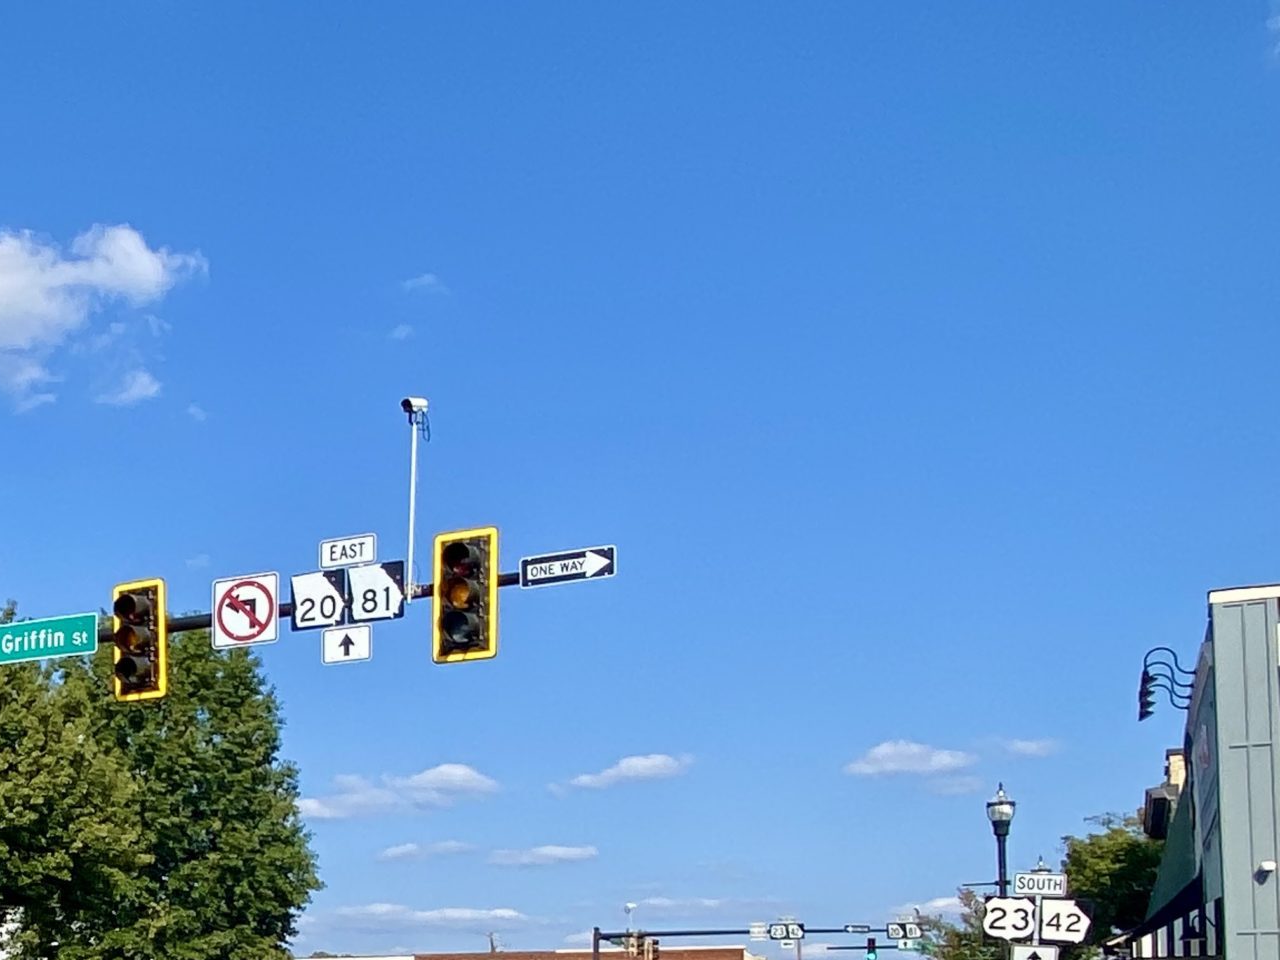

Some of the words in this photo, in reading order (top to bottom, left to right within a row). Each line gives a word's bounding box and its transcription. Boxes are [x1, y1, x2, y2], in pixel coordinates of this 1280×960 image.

[329, 542, 366, 562] EAST
[530, 563, 556, 578] ONE
[560, 560, 585, 573] WAY
[300, 595, 336, 622] 20
[361, 586, 390, 613] 81
[1, 628, 65, 654] Griffin
[1016, 876, 1063, 891] SOUTH
[988, 907, 1030, 931] 23
[1045, 912, 1081, 932] 42
